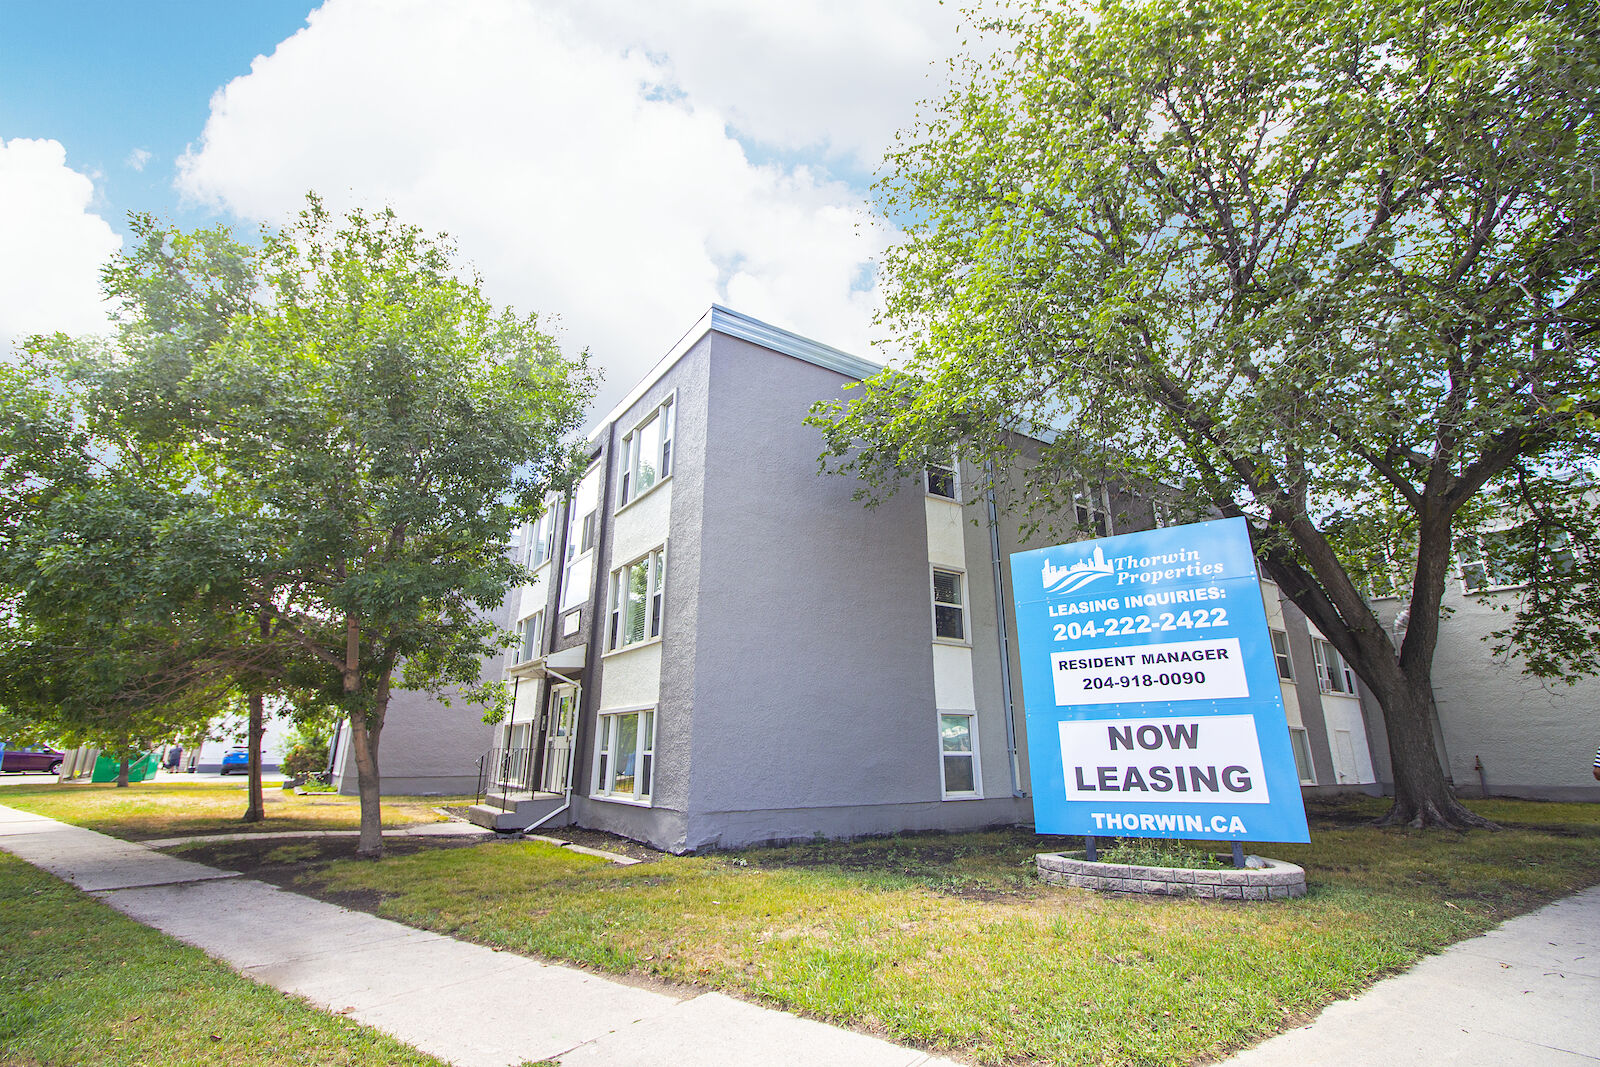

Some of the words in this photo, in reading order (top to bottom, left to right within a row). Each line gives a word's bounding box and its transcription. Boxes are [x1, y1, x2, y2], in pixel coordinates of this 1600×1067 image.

[1114, 548, 1199, 571] Thorwin
[1117, 560, 1224, 586] Properties
[1049, 597, 1119, 617] LEASING
[1125, 587, 1226, 608] INQUIRIES:
[1053, 607, 1229, 641] 204-222-2422
[1058, 655, 1136, 671] RESIDENT
[1142, 648, 1229, 665] MANAGER
[1083, 671, 1206, 690] 204-918-0090
[1108, 723, 1199, 750] NOW
[1075, 765, 1252, 792] LEASING
[1091, 813, 1247, 833] THORWIN.CA
